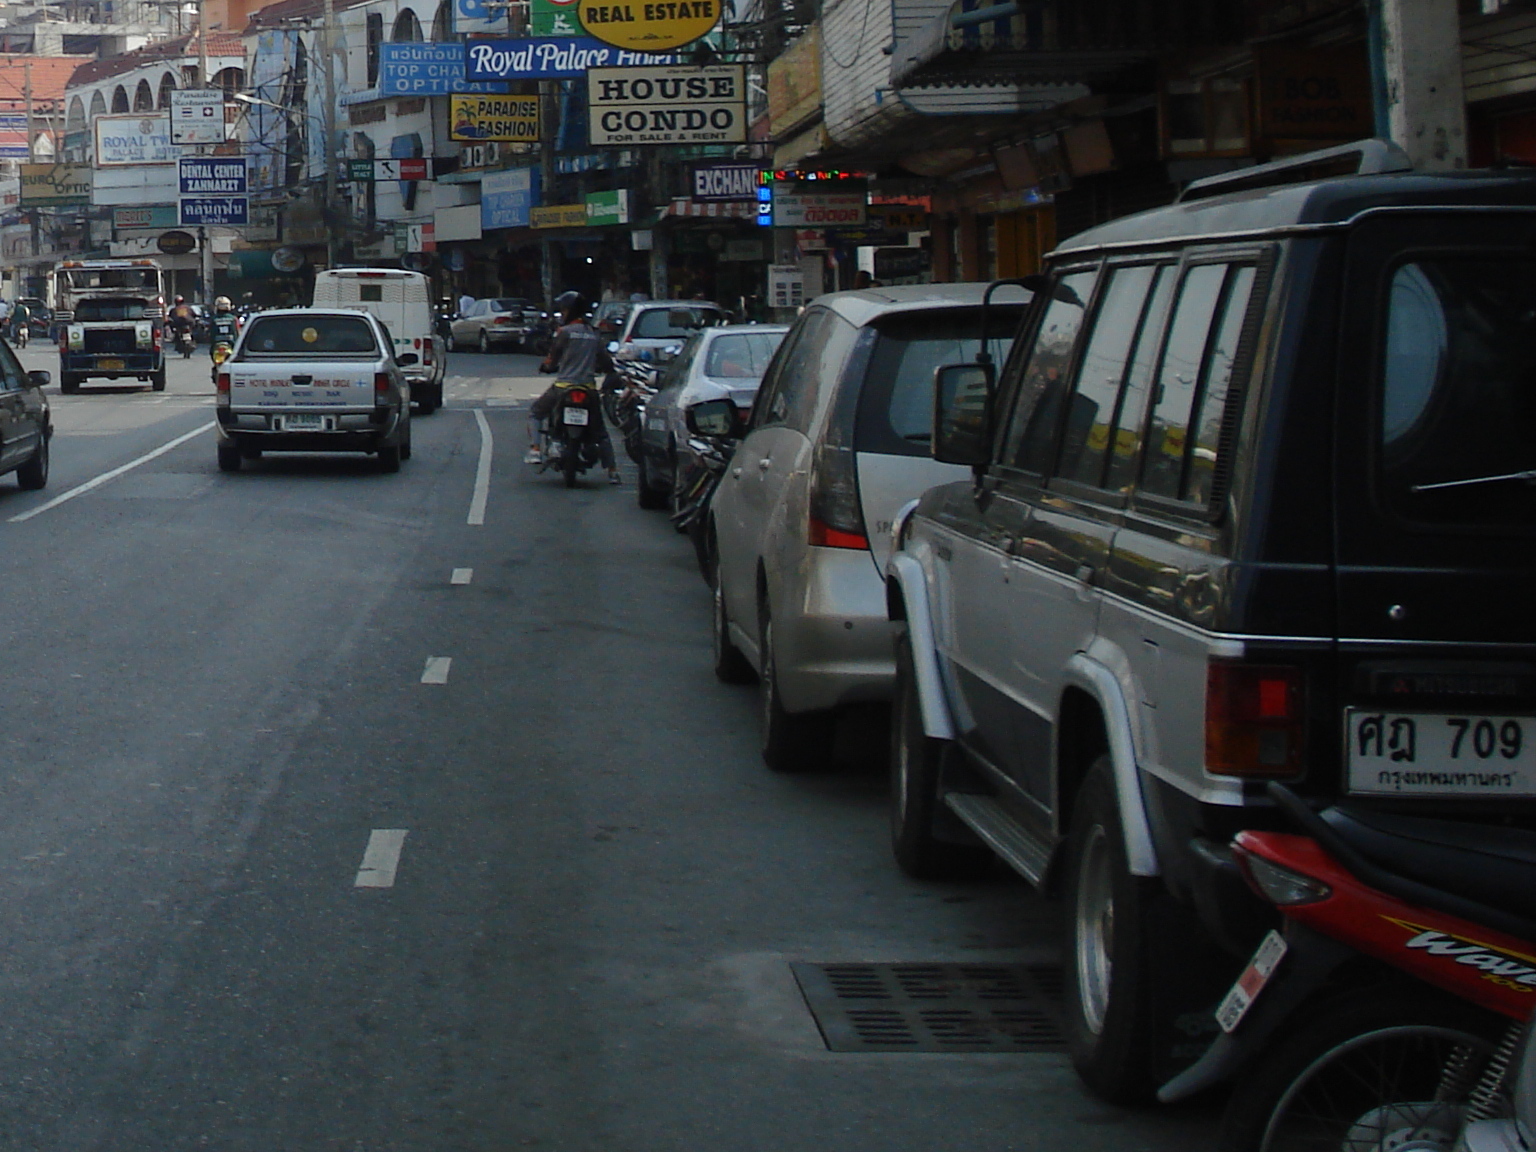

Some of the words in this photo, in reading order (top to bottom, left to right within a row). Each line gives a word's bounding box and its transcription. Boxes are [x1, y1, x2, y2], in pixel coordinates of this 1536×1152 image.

[586, 5, 635, 24] REAL
[644, 1, 713, 21] ESTATE
[469, 44, 534, 77] Royal
[535, 42, 610, 72] Palace
[387, 65, 419, 77] TOP
[427, 65, 466, 77] CHA
[395, 78, 497, 92] OPTICAL
[598, 76, 735, 101] HOUSE
[477, 100, 537, 117] PARADISE
[477, 118, 537, 138] FASHION
[601, 108, 734, 133] CONDO
[102, 135, 147, 148] ROYAL
[606, 134, 633, 142] FOR
[638, 134, 673, 142] SALE
[692, 132, 728, 141] RENT
[23, 174, 55, 185] EURO
[181, 164, 213, 178] DENTAL
[214, 164, 244, 178] CENTER
[55, 182, 91, 194] OPTIC
[696, 167, 759, 196] EXCHANG
[1447, 718, 1524, 759] 709
